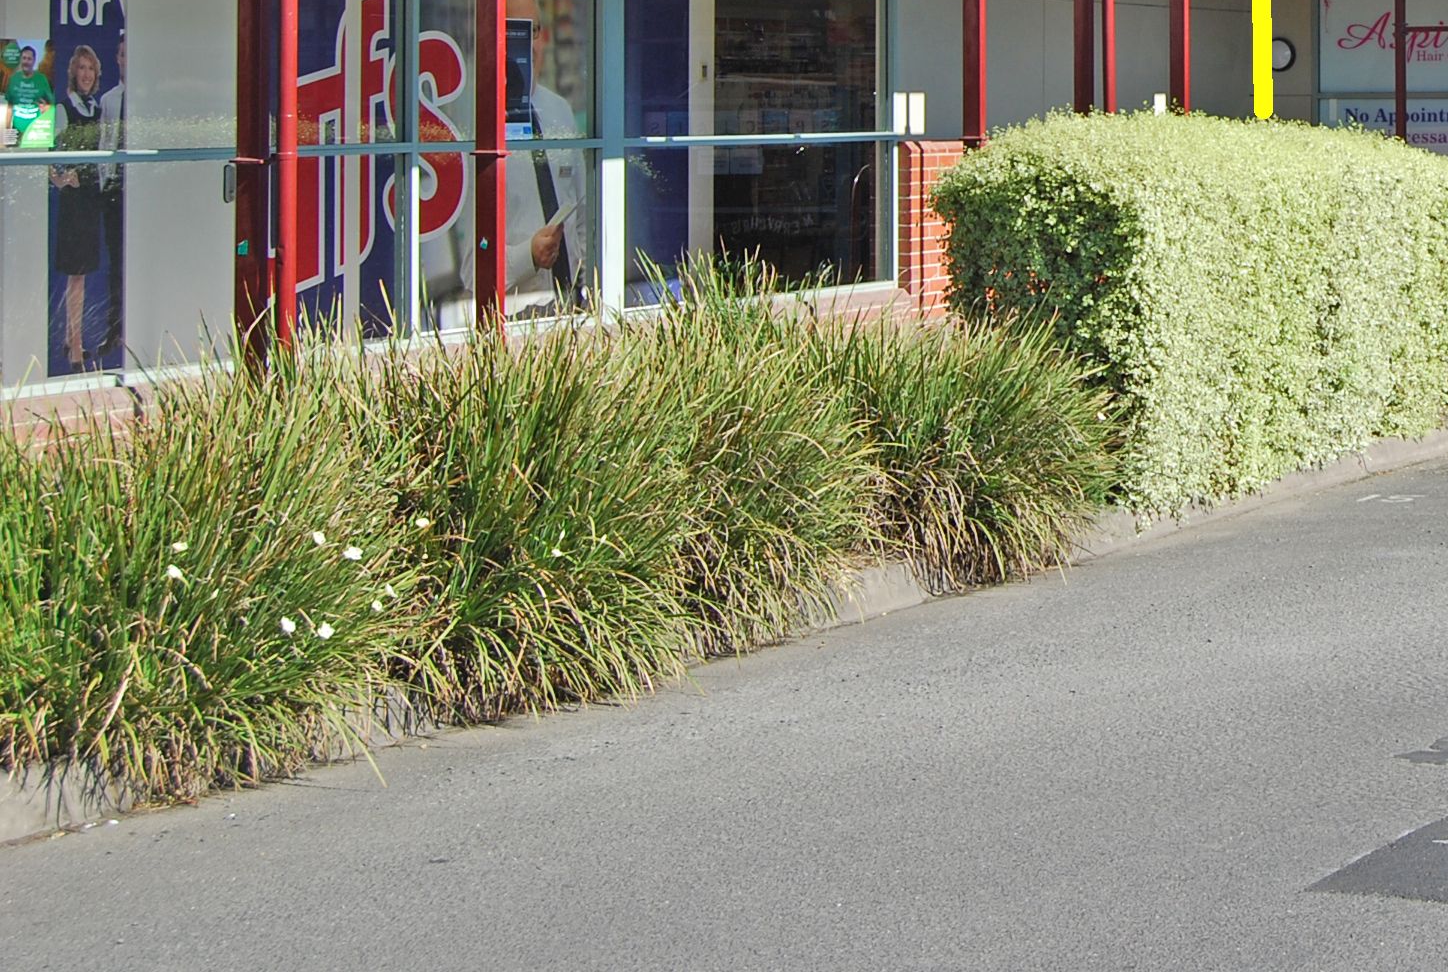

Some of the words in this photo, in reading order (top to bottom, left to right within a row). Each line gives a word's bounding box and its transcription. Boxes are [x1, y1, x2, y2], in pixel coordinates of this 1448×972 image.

[1416, 50, 1445, 62] Hair
[1344, 107, 1370, 124] No
[1356, 494, 1426, 503] 15
